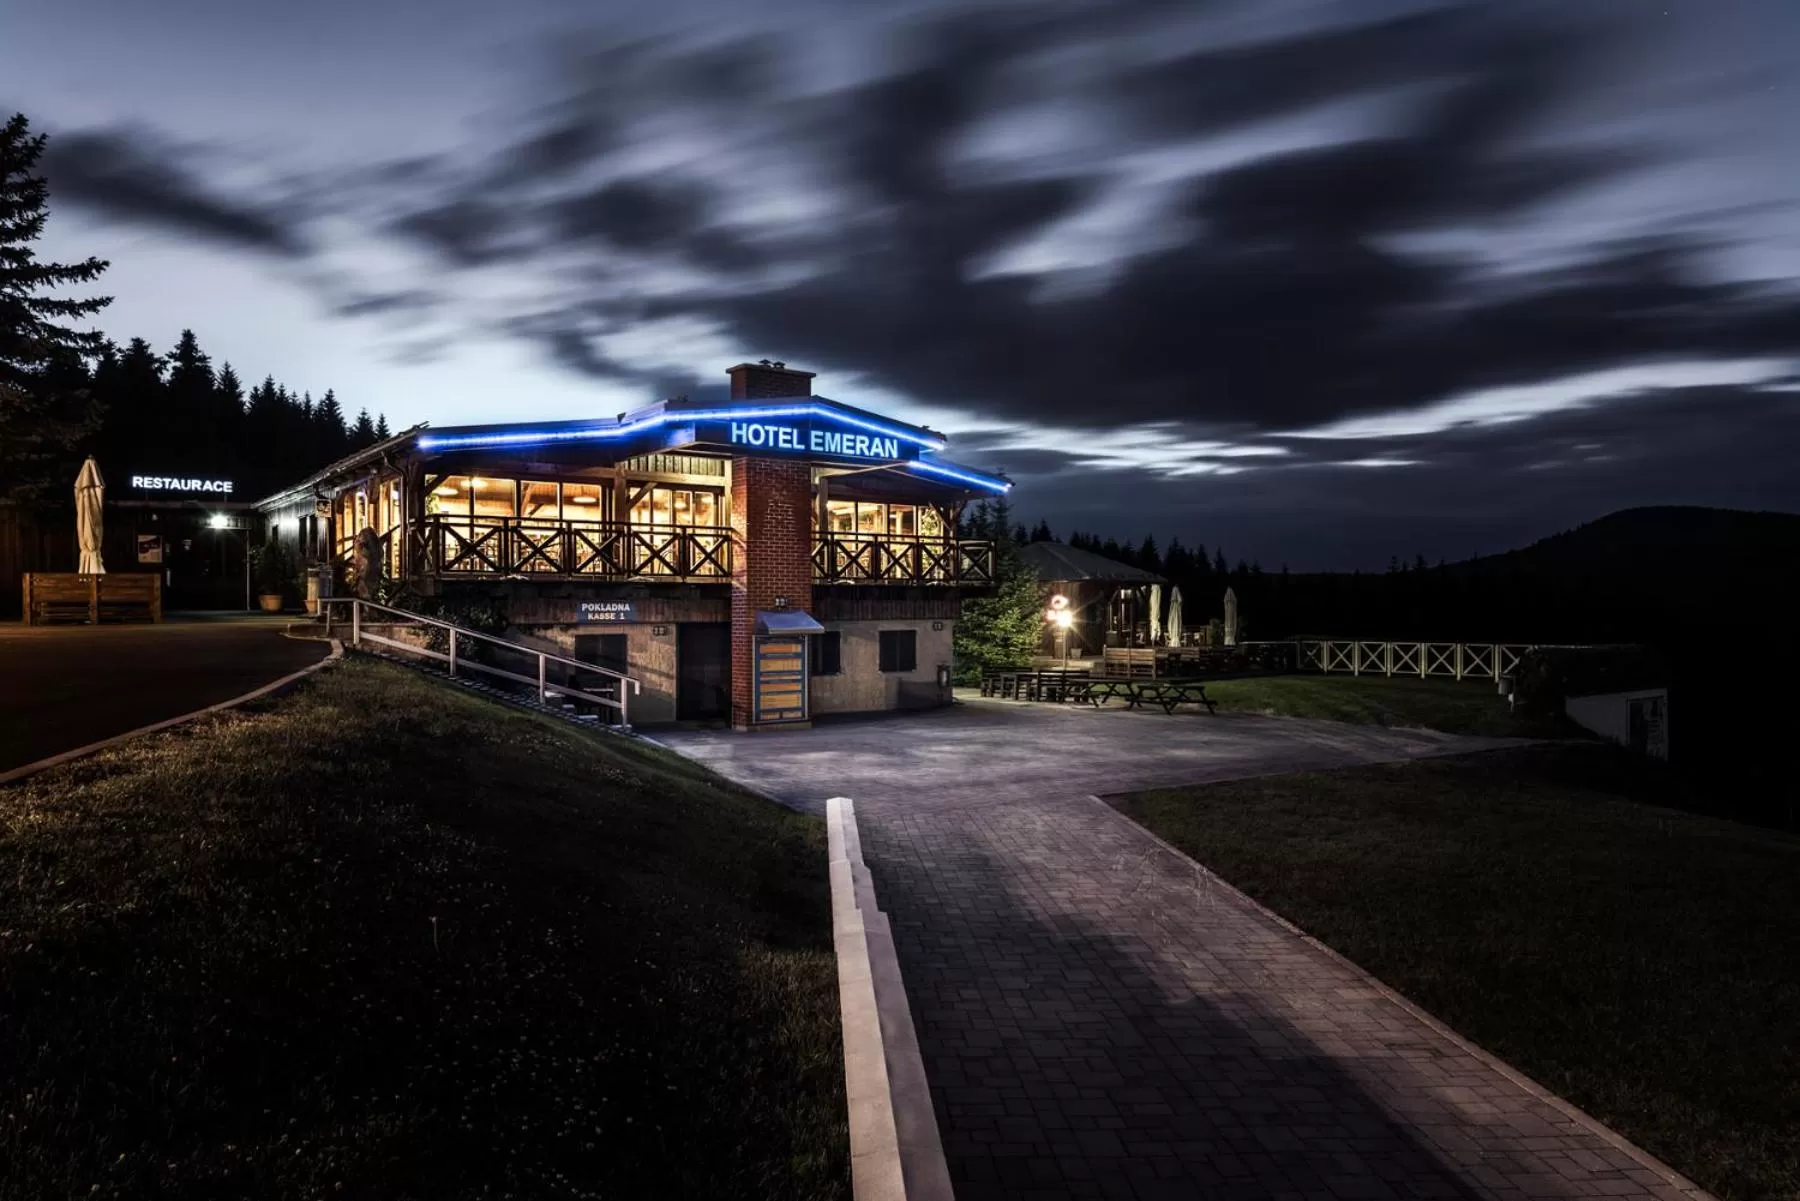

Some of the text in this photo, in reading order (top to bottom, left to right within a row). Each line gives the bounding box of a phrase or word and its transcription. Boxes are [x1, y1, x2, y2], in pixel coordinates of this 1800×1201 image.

[731, 421, 899, 459] HOTEL EMERAN
[131, 475, 234, 493] RESTAURACE
[581, 602, 631, 612] POKLADNA
[587, 612, 625, 620] KASSE 1
